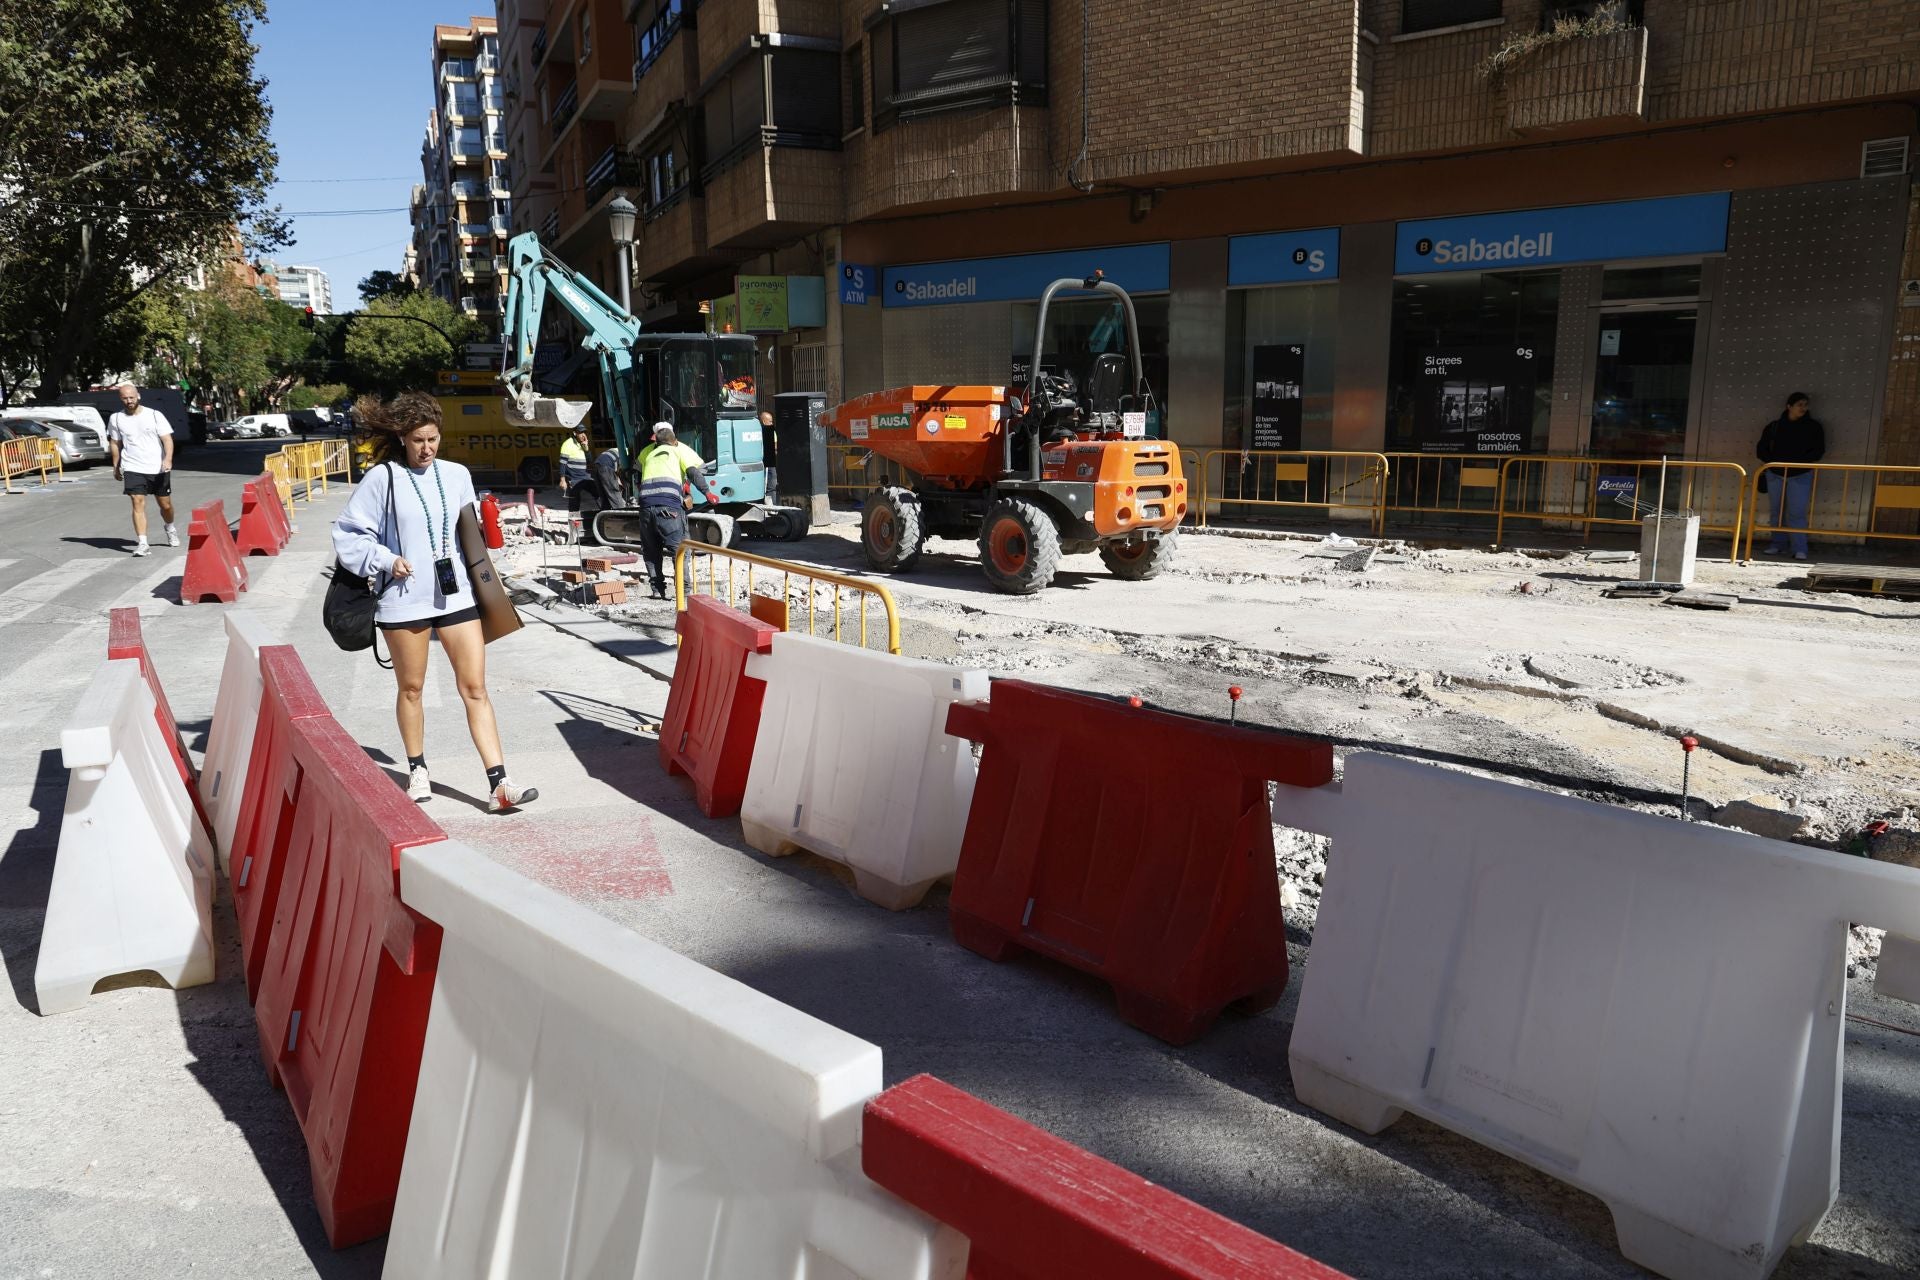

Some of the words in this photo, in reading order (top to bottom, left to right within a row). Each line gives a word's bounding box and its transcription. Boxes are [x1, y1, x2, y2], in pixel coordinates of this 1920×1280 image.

[1433, 232, 1553, 264] Sabadell
[740, 281, 784, 290] pyromagic
[906, 277, 976, 300] Sabadell
[846, 290, 864, 302] ATM
[1425, 356, 1434, 366] Si
[1436, 357, 1462, 365] crees
[1012, 364, 1020, 372] Si
[1438, 366, 1448, 376] ti,
[880, 416, 908, 426] AUSA
[468, 433, 569, 450] PROSEG
[1478, 432, 1521, 441] nosotros
[1478, 442, 1520, 451] también.
